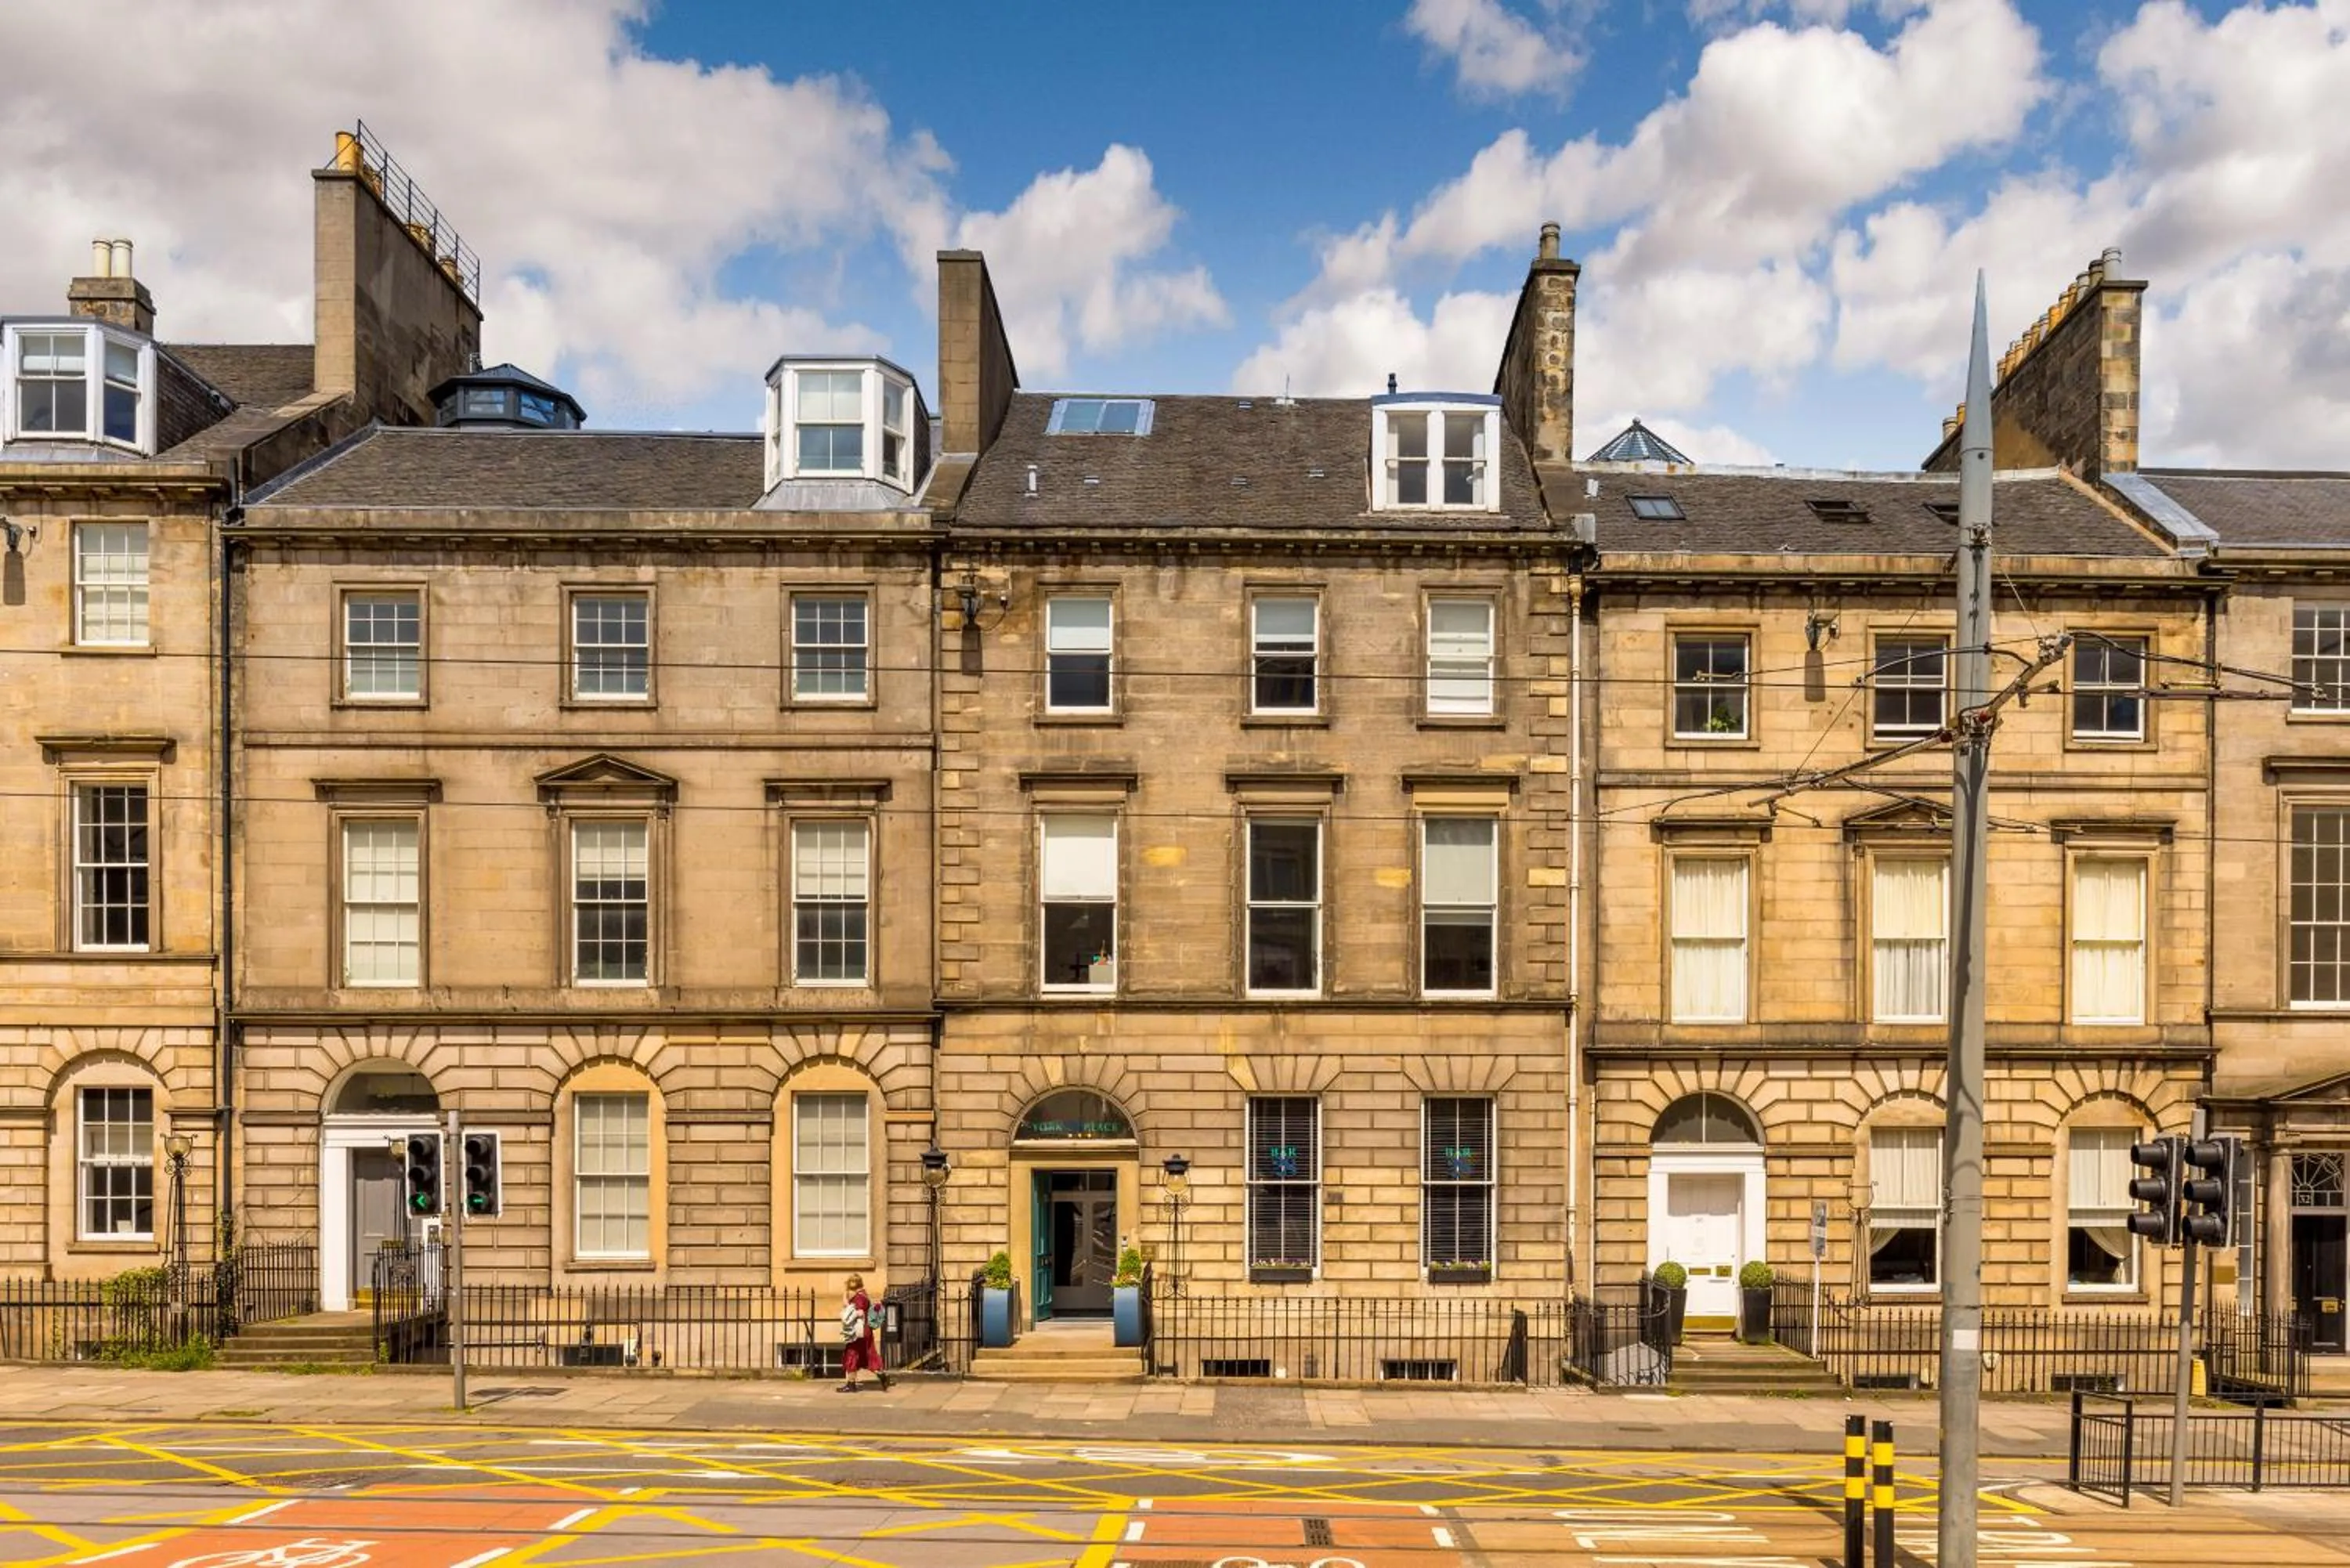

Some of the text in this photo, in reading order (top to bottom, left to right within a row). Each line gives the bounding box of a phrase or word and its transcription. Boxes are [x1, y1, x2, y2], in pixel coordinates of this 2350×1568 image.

[1032, 1121, 1118, 1132] YORK PLACE
[1271, 1146, 1297, 1157] BAR
[1445, 1147, 1471, 1158] BAR
